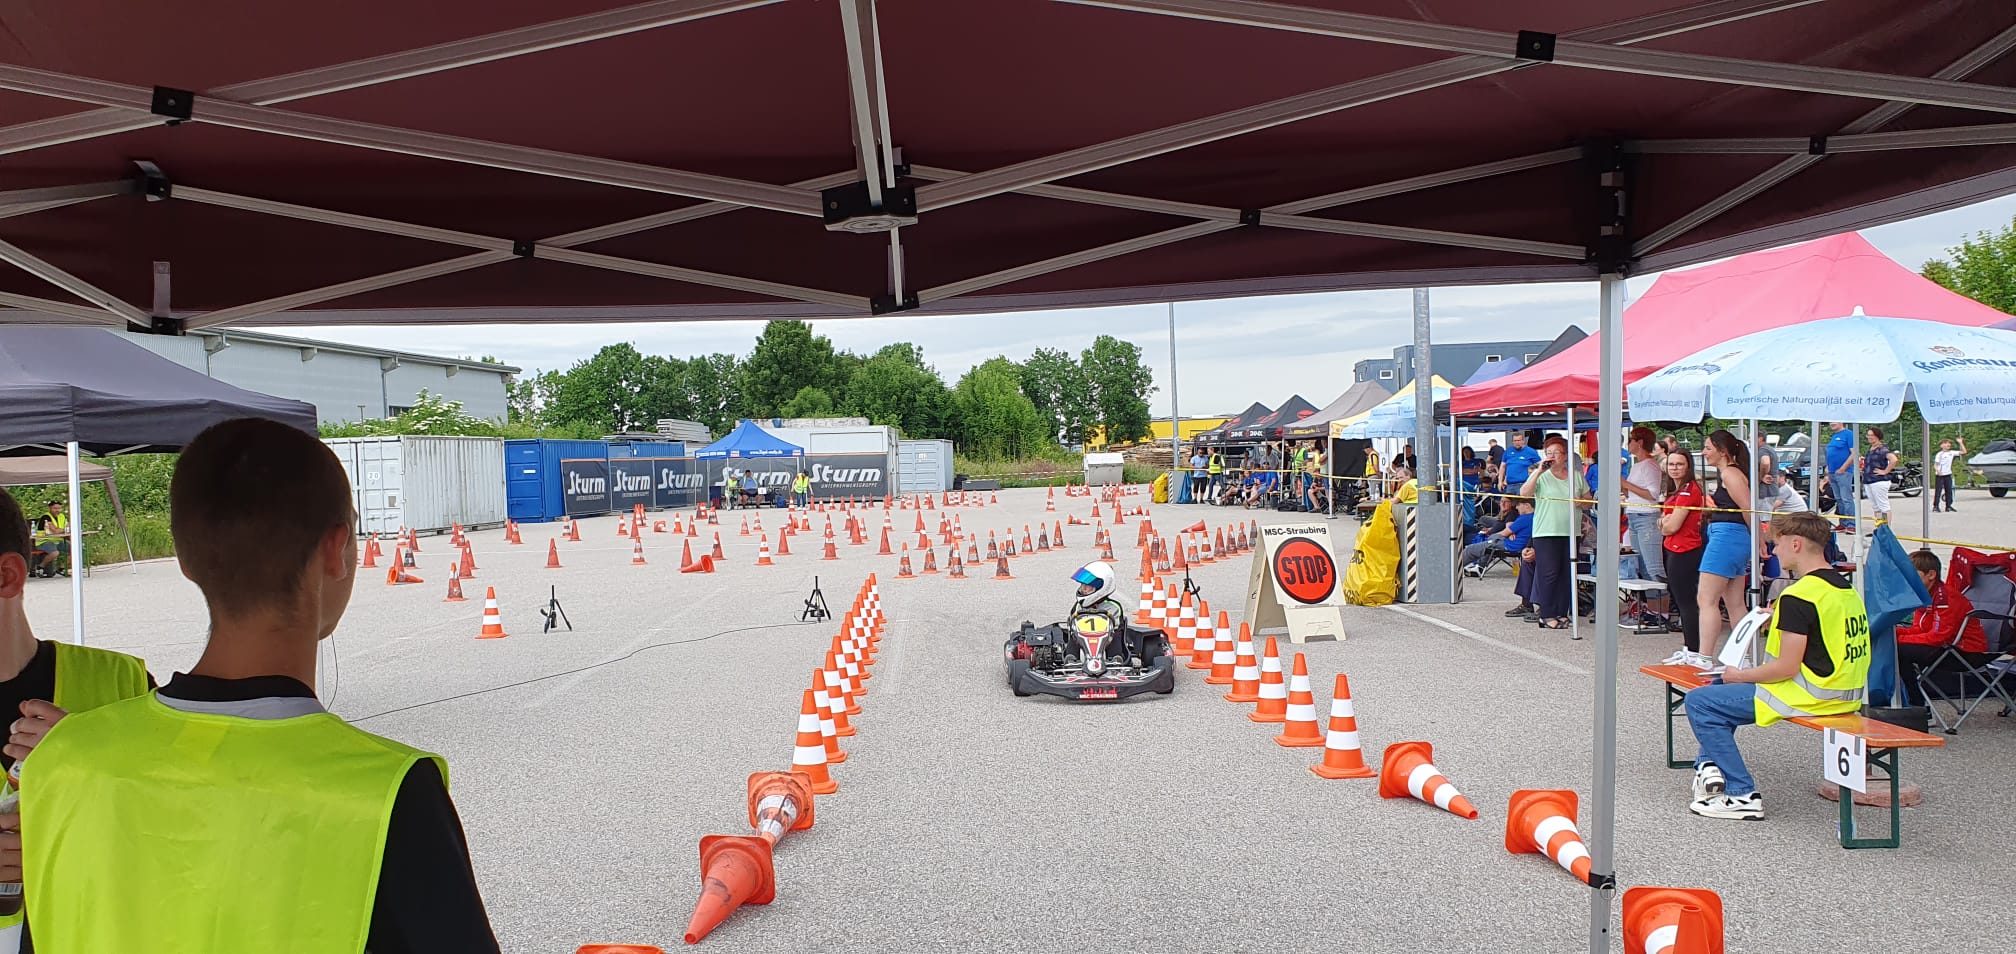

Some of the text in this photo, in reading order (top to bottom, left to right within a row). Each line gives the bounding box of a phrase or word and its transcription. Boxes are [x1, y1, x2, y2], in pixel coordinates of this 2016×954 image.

[1727, 396, 1890, 406] Bayerische Naturqualität seit 1281
[1975, 395, 2016, 406] Naturqua
[567, 470, 606, 494] Sturm
[613, 469, 651, 491] Sturm
[657, 467, 704, 489] Sturm
[810, 463, 881, 483] Sturm
[1264, 526, 1327, 536] MSC-Straubing
[1281, 555, 1328, 585] STOP
[1084, 618, 1095, 631] 1
[1735, 620, 1753, 644] 0
[1837, 746, 1850, 777] 6
